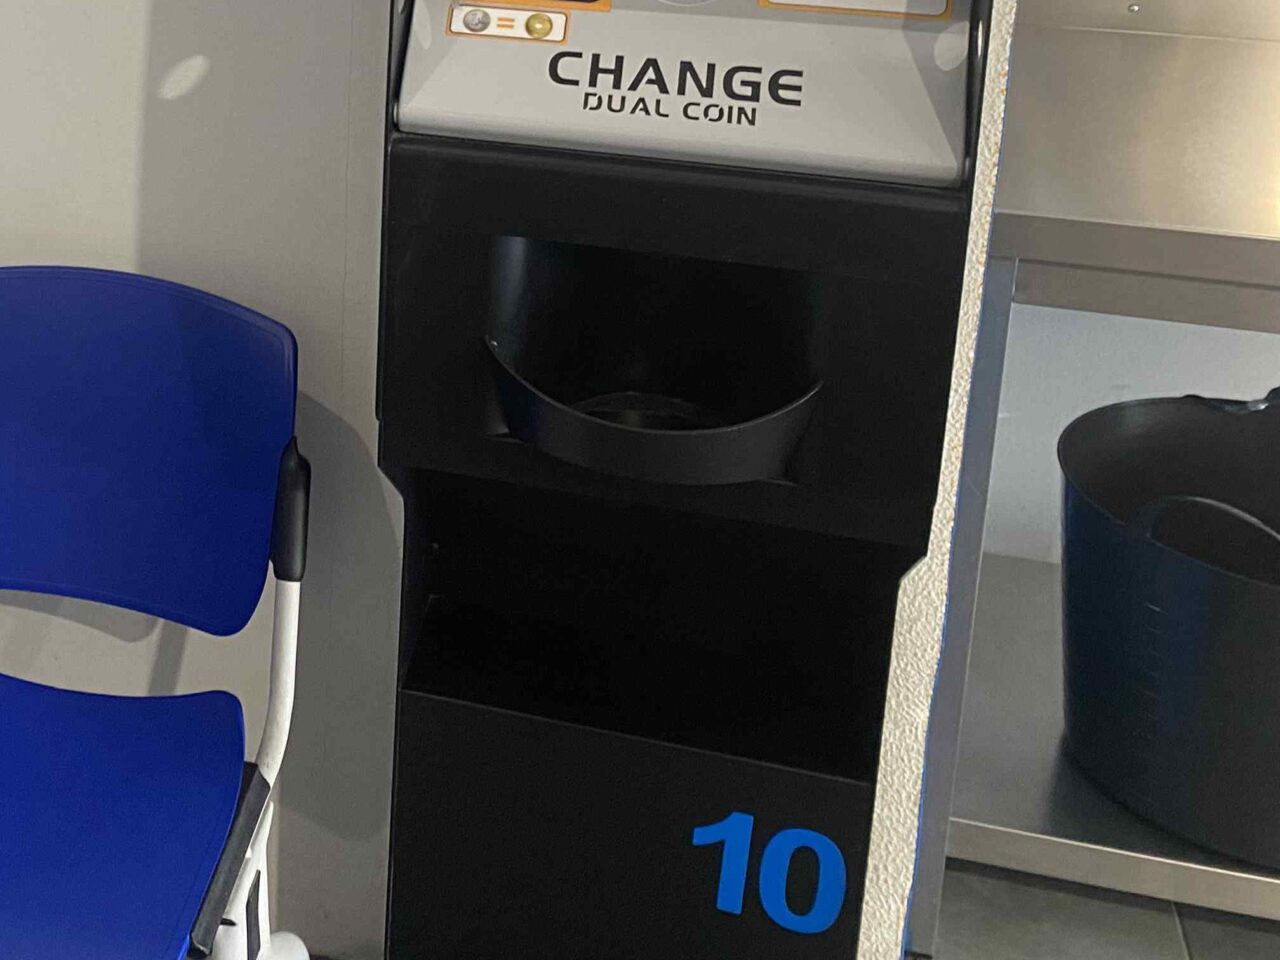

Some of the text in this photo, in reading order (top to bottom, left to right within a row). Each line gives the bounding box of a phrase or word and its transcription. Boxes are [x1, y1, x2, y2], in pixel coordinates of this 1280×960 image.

[548, 50, 804, 106] CHANGE
[582, 93, 757, 126] DUAL COIN
[692, 812, 846, 934] 10
